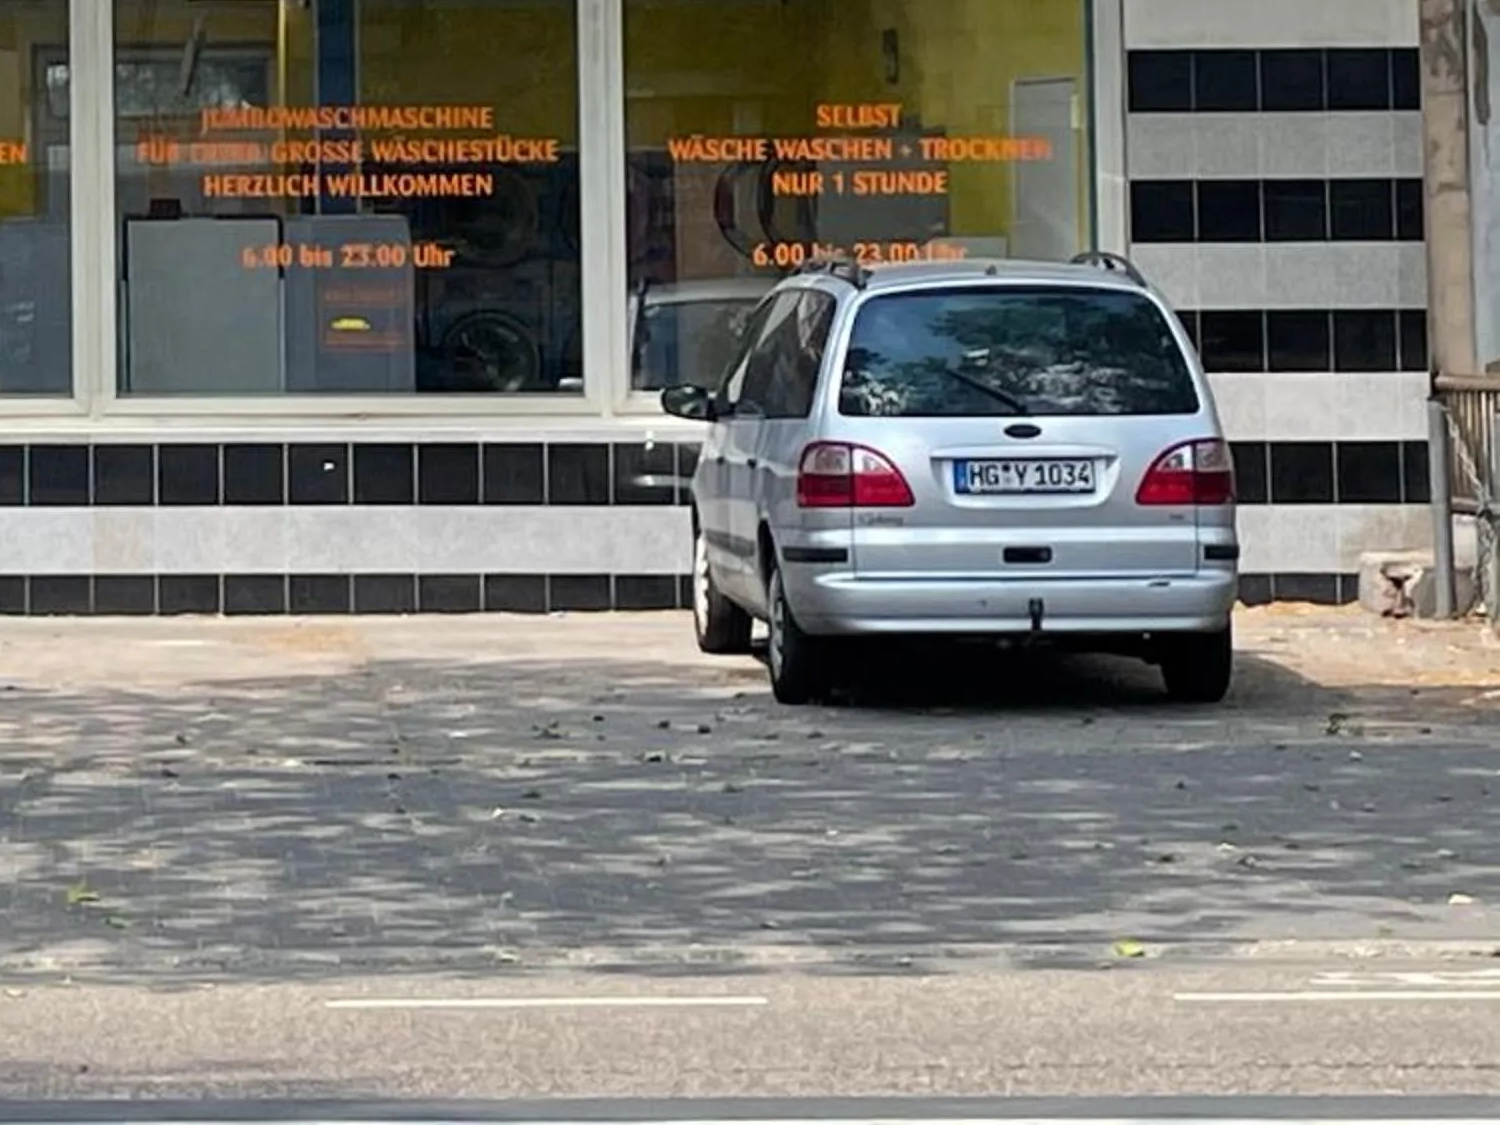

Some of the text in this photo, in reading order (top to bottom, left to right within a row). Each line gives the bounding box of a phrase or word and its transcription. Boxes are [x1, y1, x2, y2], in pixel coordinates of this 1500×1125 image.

[817, 104, 902, 127] SELBST
[372, 133, 560, 163] WÄSCHESTÜCKE
[668, 134, 768, 161] WÄSCHE
[773, 137, 892, 161] WASCHEN
[203, 173, 493, 197] HERZLICH WILLKOMMEN
[773, 171, 948, 196] NUR 1 STUNDE
[300, 243, 333, 267] bis
[341, 244, 406, 267] 23.00
[414, 242, 455, 267] Uhr
[753, 243, 805, 266] 6.00
[970, 463, 999, 487] HG
[1034, 463, 1090, 486] 1034
